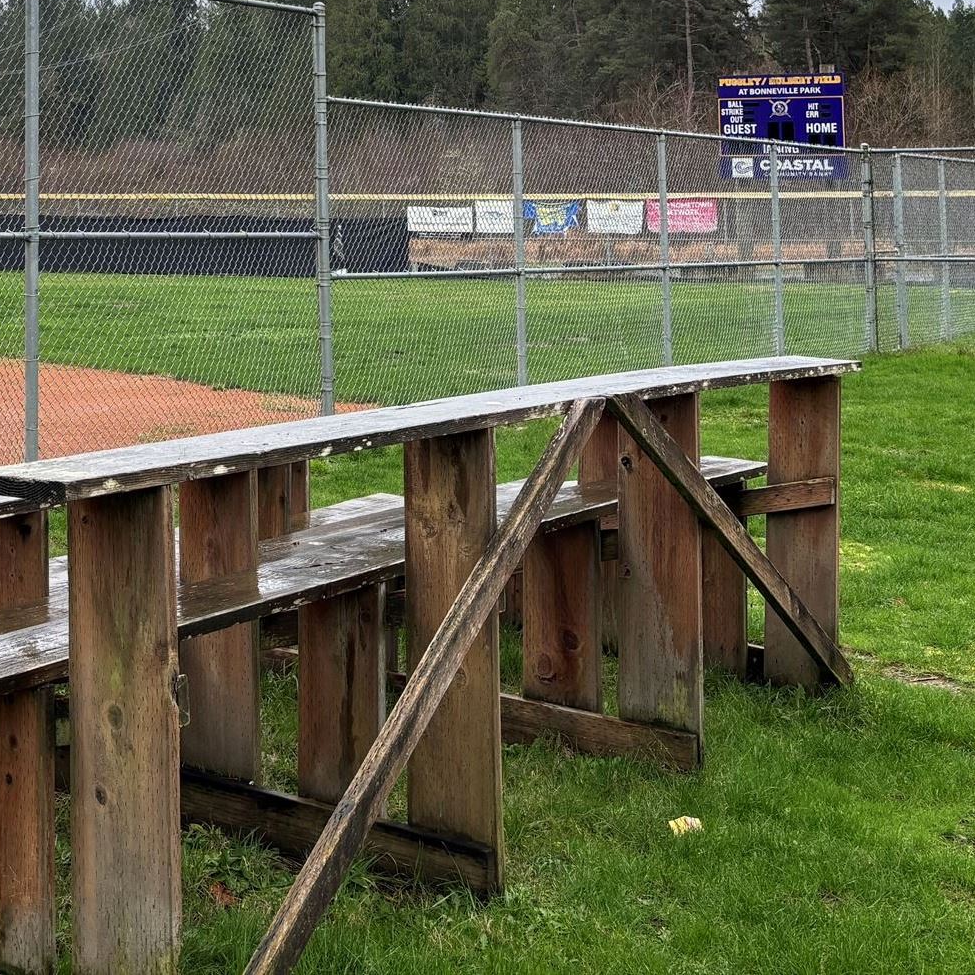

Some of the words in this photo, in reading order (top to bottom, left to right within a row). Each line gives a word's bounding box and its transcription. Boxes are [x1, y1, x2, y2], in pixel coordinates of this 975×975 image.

[813, 75, 841, 84] FIELD
[749, 87, 799, 95] BONNEVILLE
[800, 86, 822, 94] PARK
[724, 124, 757, 134] GUEST
[806, 123, 838, 133] HOME
